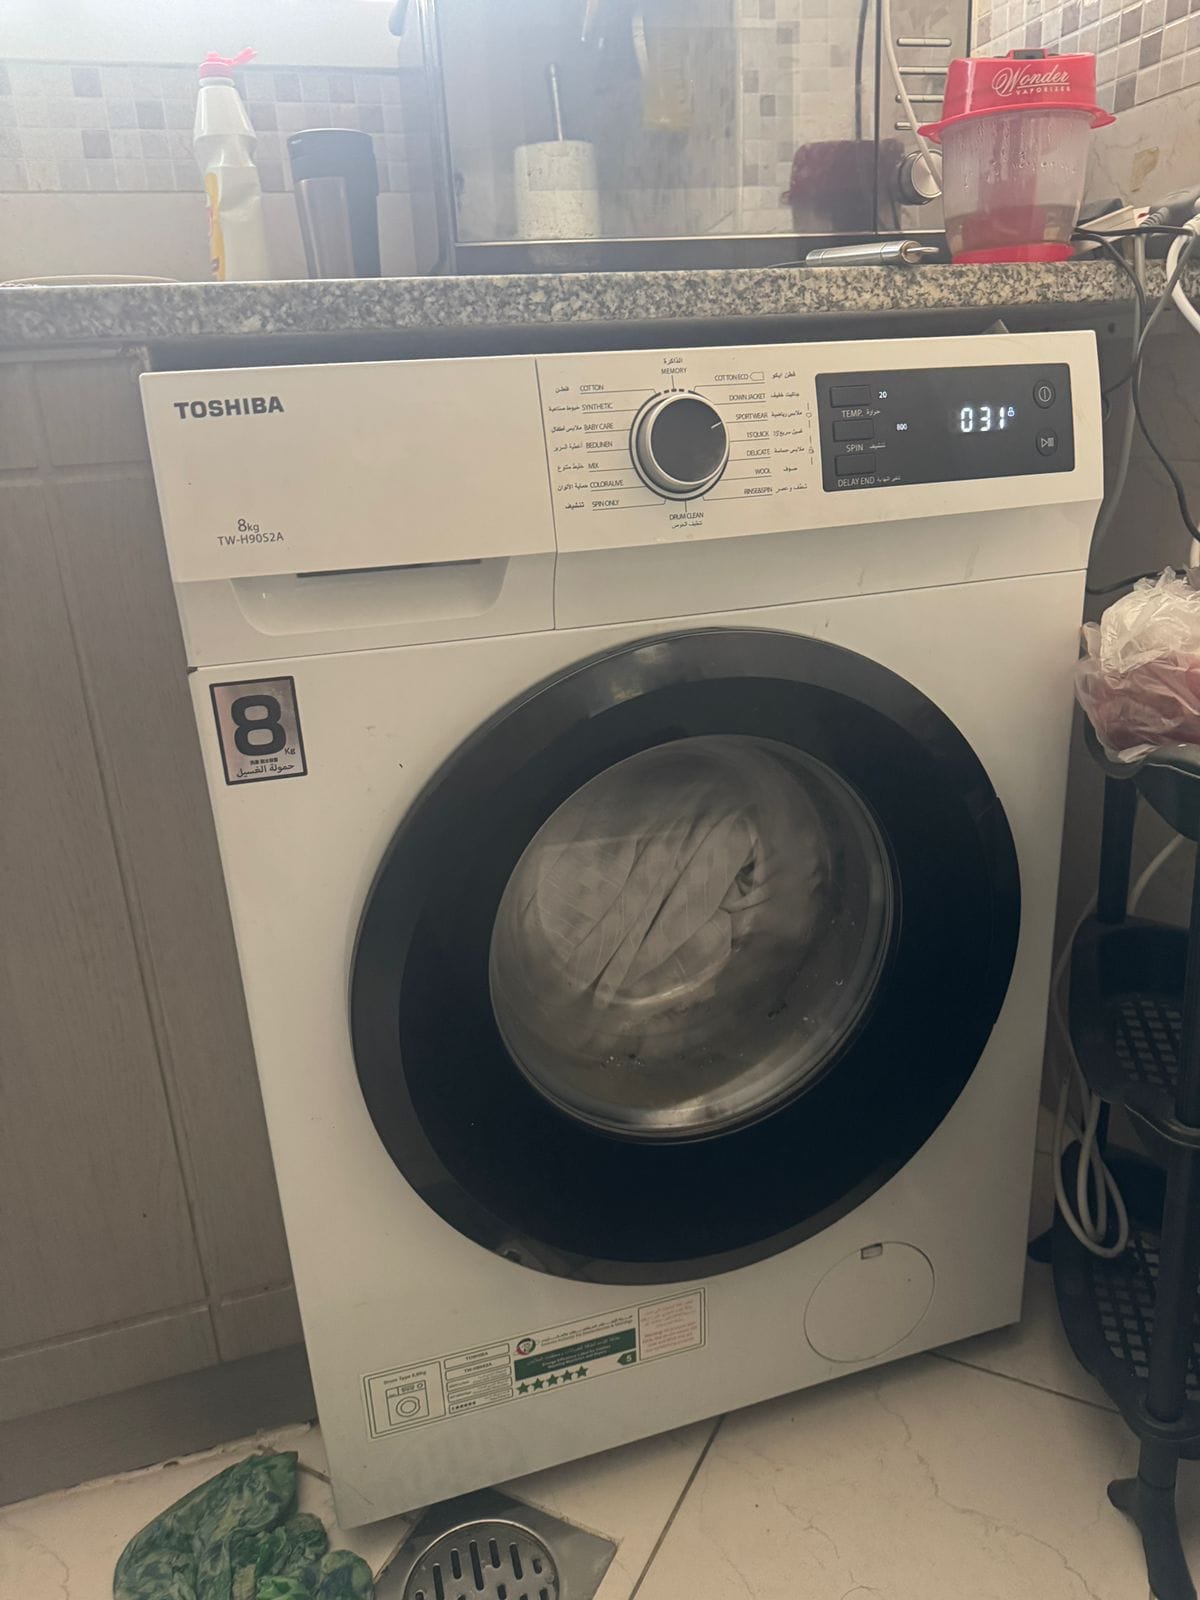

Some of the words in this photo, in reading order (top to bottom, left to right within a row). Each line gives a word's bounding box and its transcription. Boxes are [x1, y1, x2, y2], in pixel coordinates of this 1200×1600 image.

[992, 64, 1070, 97] Wonder
[580, 384, 604, 392] COTTON
[878, 391, 888, 399] 20
[174, 396, 284, 419] TOSHIBA
[581, 402, 613, 411] SYNTHETIC
[841, 409, 864, 418] TEMP.
[961, 407, 1005, 432] 031
[583, 423, 599, 431] BABY
[599, 422, 614, 430] CARE
[747, 448, 770, 456] DELICATE
[846, 443, 864, 452] SPIN
[838, 478, 859, 487] DELAY
[860, 476, 875, 485] END
[237, 518, 260, 533] 8kg
[217, 532, 284, 546] TW-H90S2A
[231, 694, 287, 756] 8
[236, 766, 267, 777] الغسيل
[269, 763, 295, 773] حمولة
[626, 1354, 633, 1362] 5
